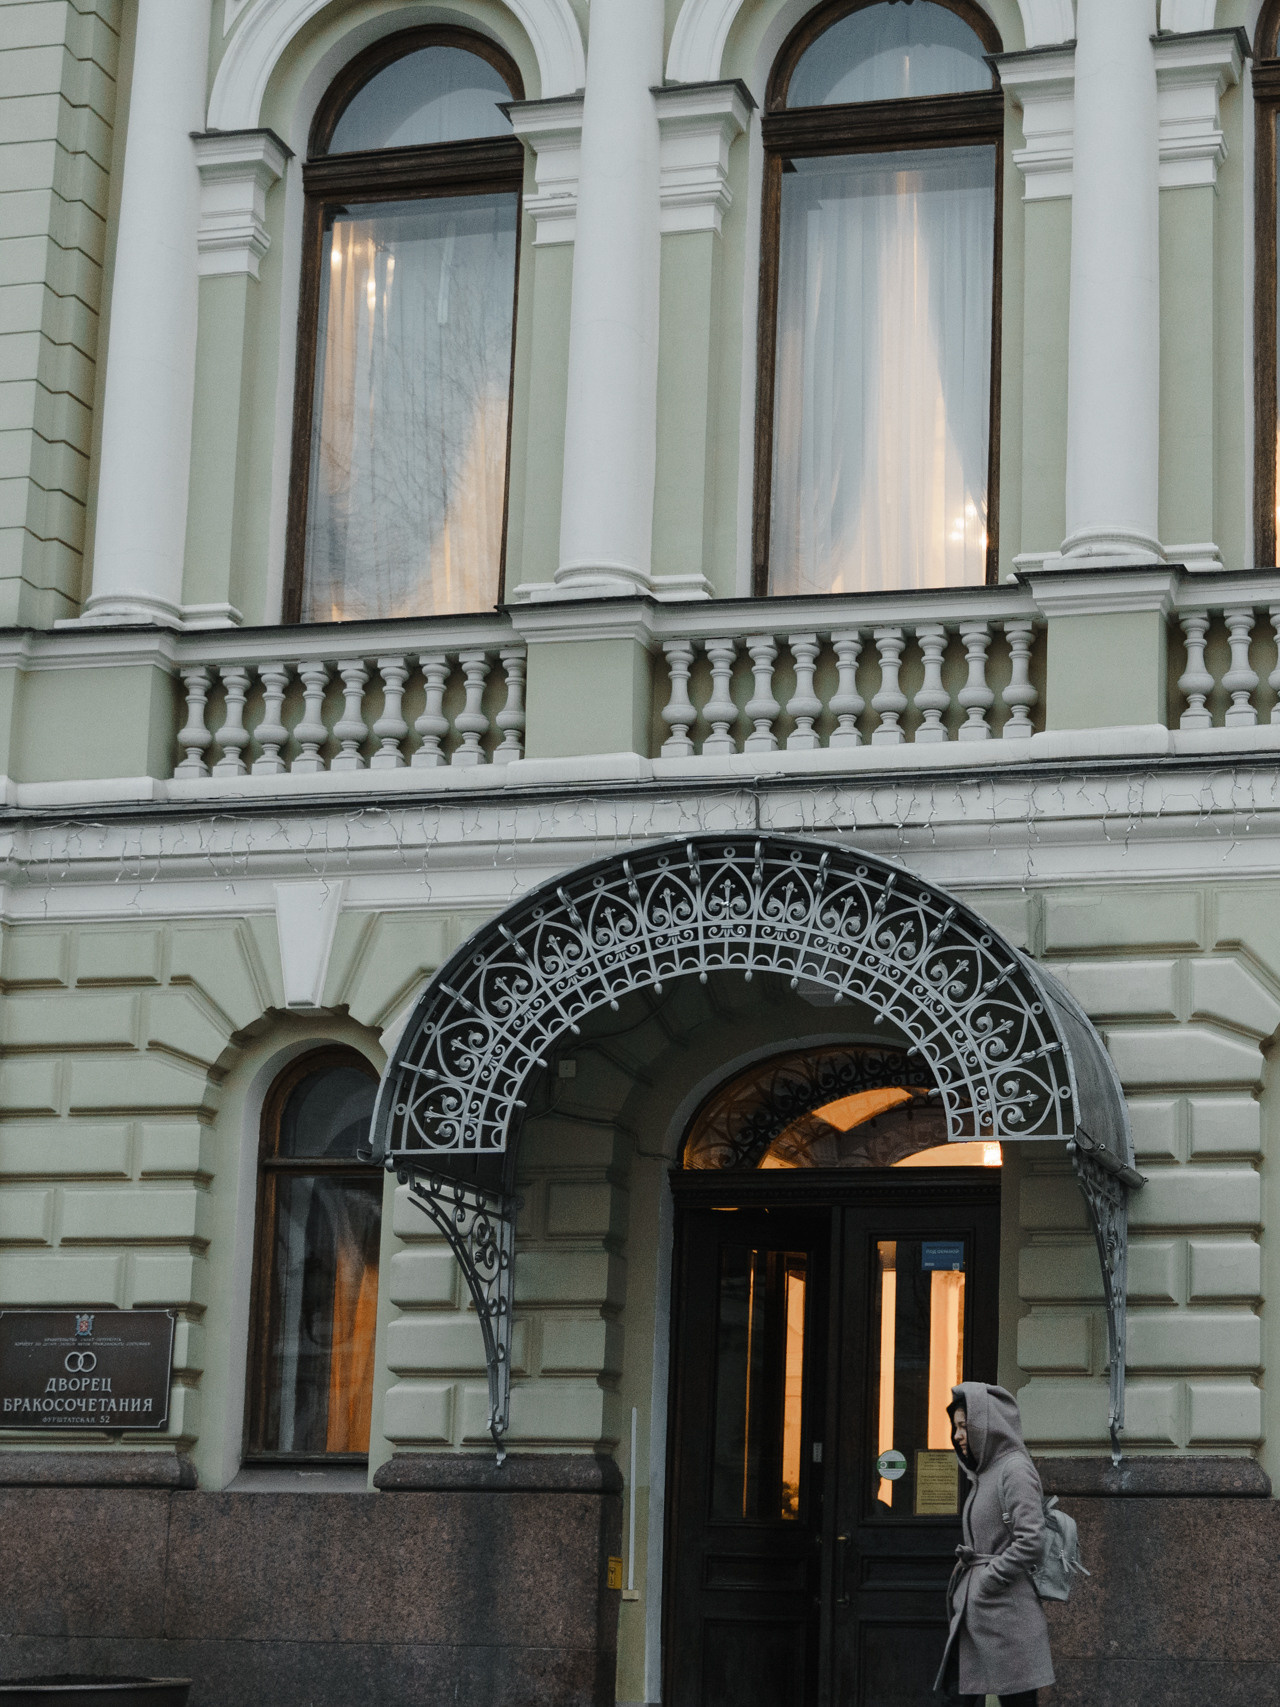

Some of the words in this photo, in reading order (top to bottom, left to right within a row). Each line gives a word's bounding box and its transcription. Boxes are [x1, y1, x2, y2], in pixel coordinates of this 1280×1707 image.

[44, 1377, 112, 1393] ДВОРЕЦ
[3, 1397, 153, 1412] БРАКОСОЧЕТАНИЯ
[99, 1415, 111, 1423] 52
